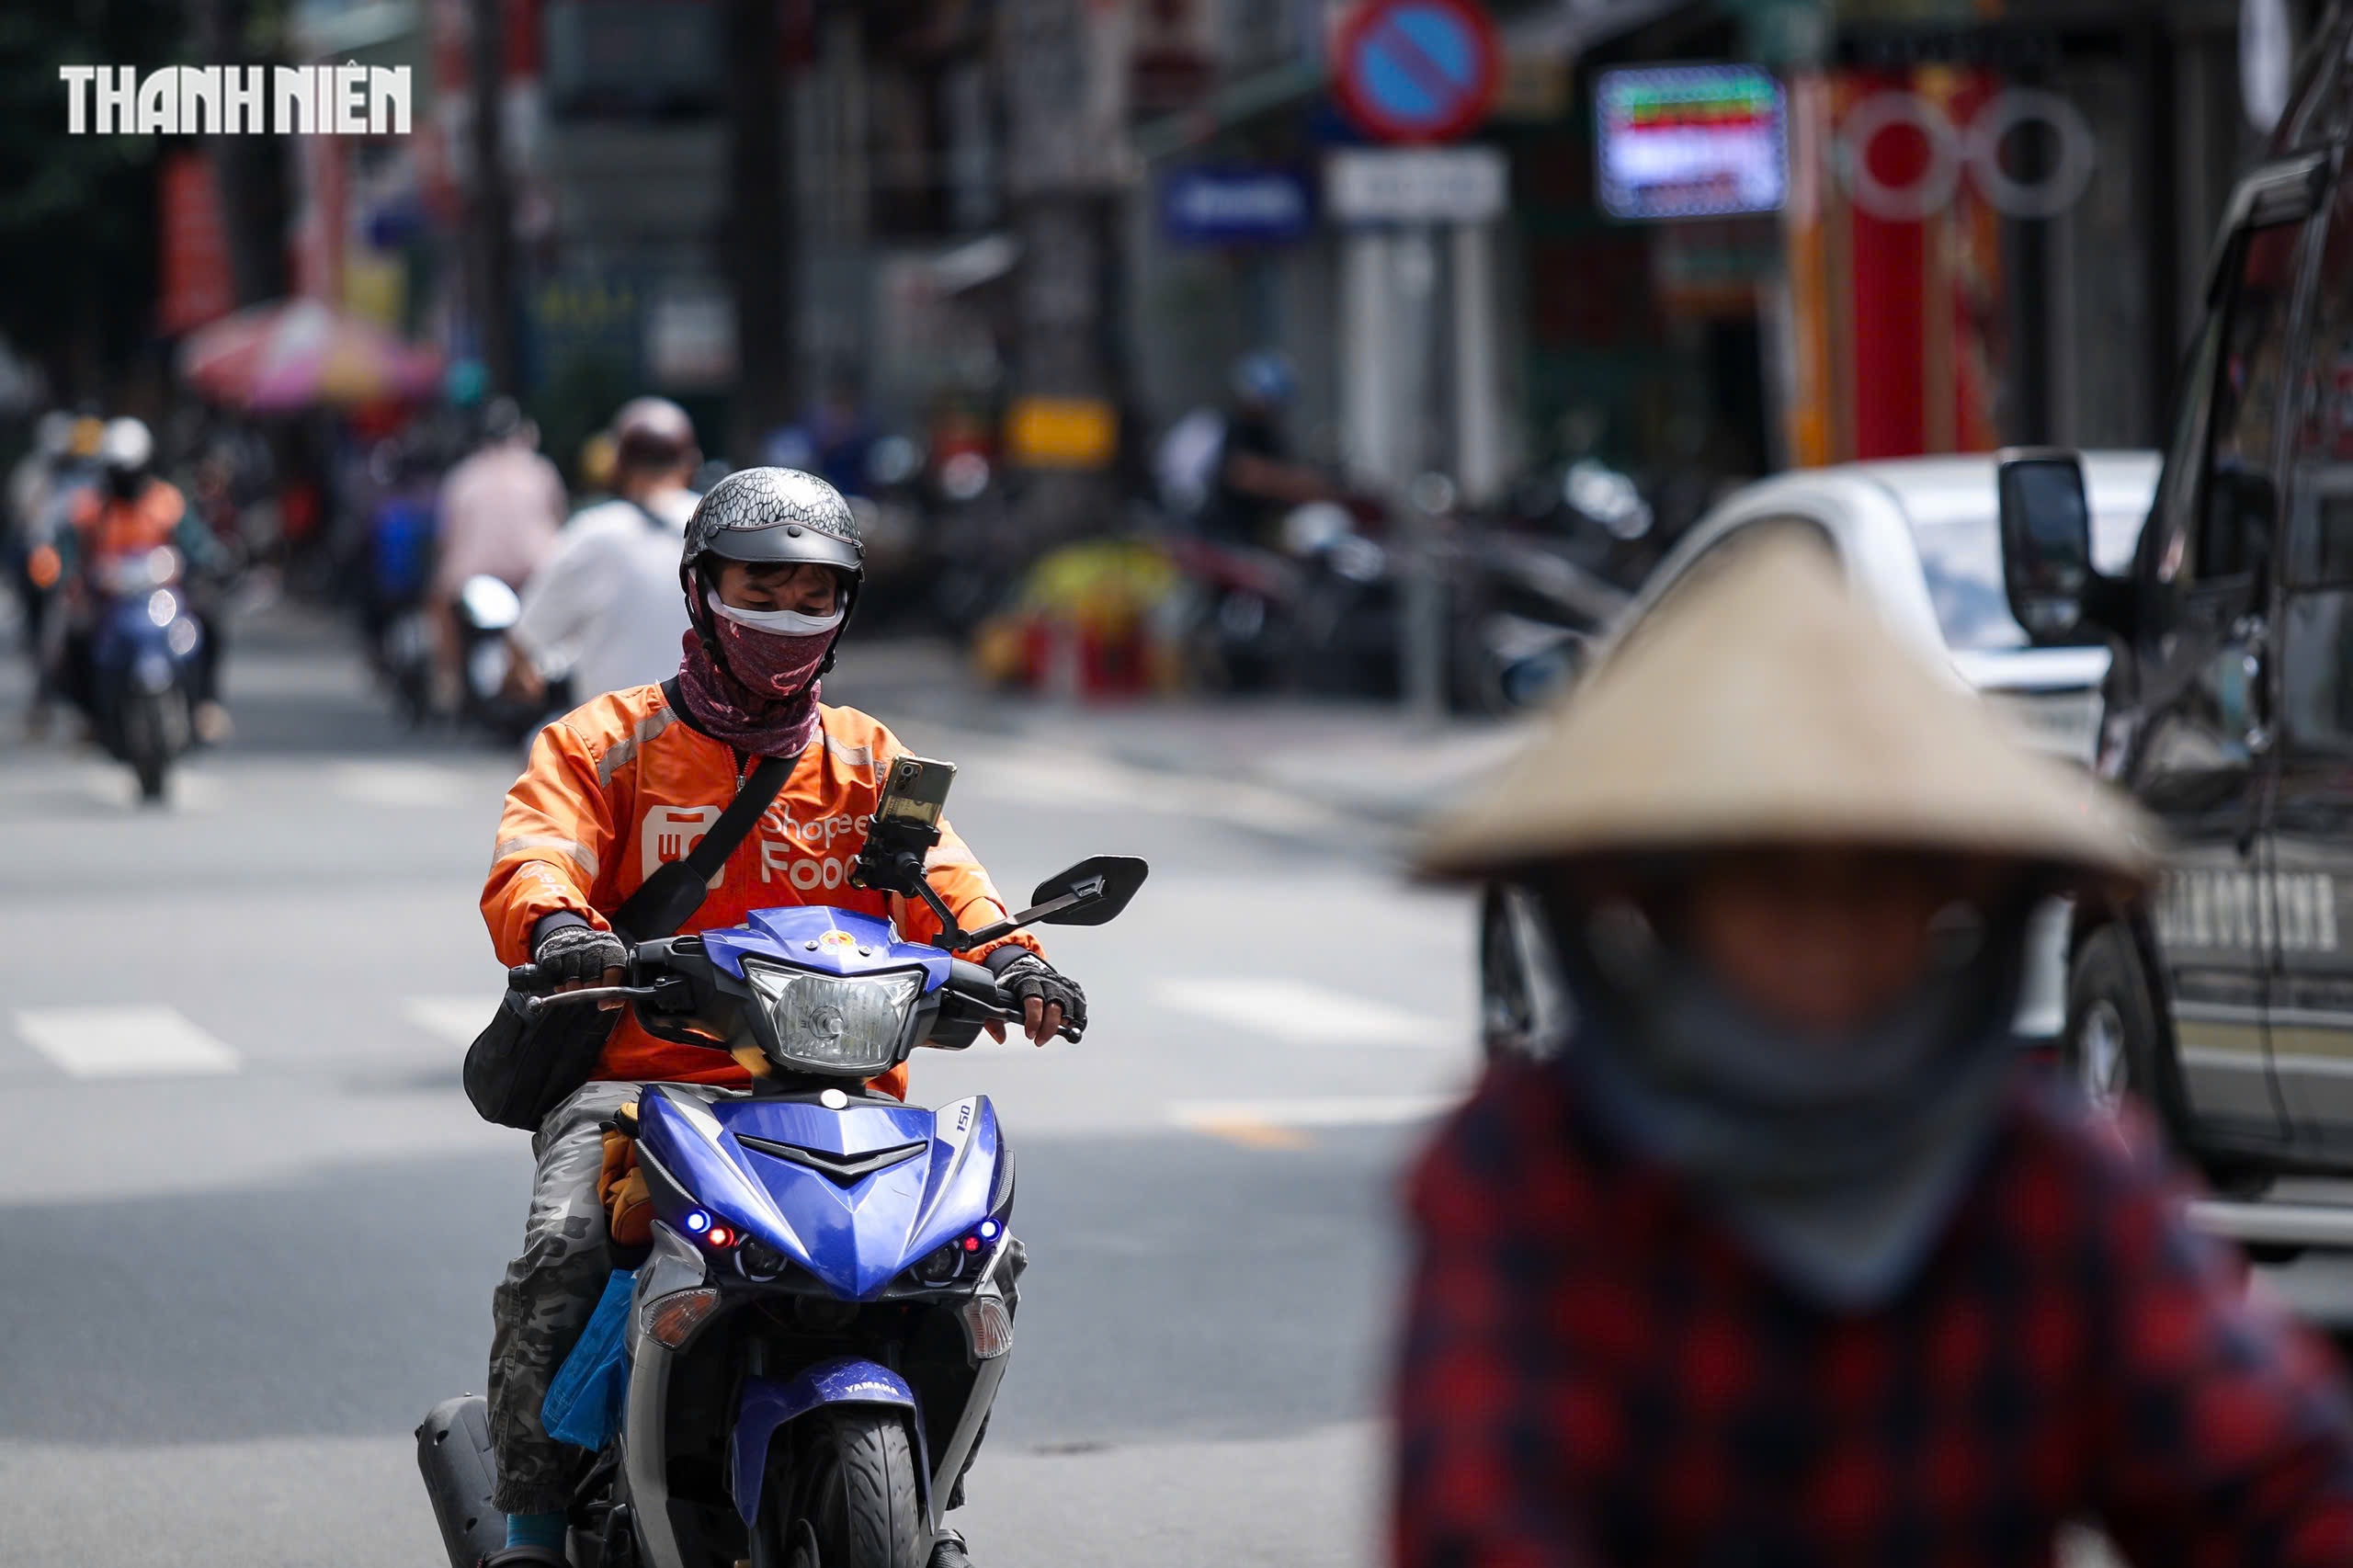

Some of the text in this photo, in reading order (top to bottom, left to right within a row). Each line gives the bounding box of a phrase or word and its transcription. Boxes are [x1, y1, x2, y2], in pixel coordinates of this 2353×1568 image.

[761, 801, 869, 849] Shopee
[957, 1105, 971, 1132] 150
[846, 1381, 900, 1396] YAMAHA
